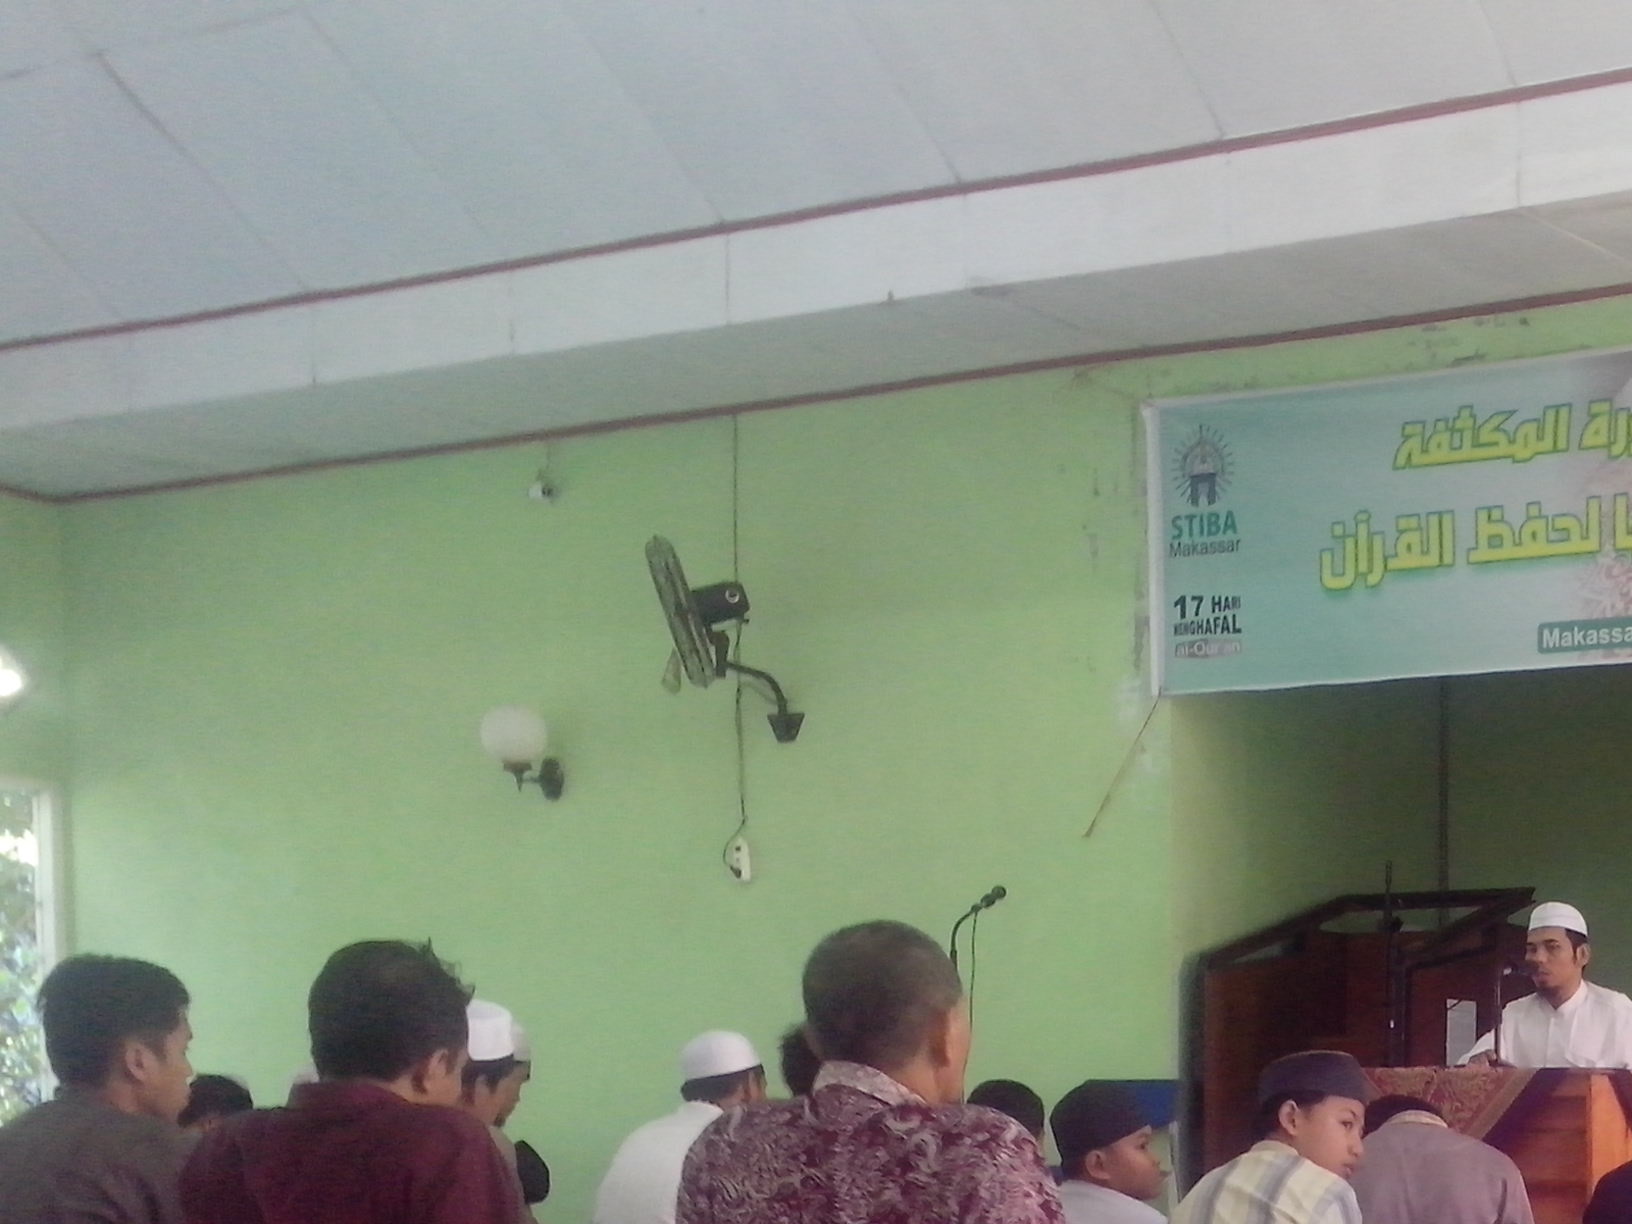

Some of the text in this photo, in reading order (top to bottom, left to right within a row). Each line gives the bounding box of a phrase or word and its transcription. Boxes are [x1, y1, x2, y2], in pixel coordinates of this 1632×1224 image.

[1392, 402, 1572, 470] المكثفة
[1171, 510, 1238, 540] STIBA
[1466, 495, 1602, 564] لحفظ
[1169, 538, 1241, 558] Makassar
[1173, 595, 1204, 620] 17
